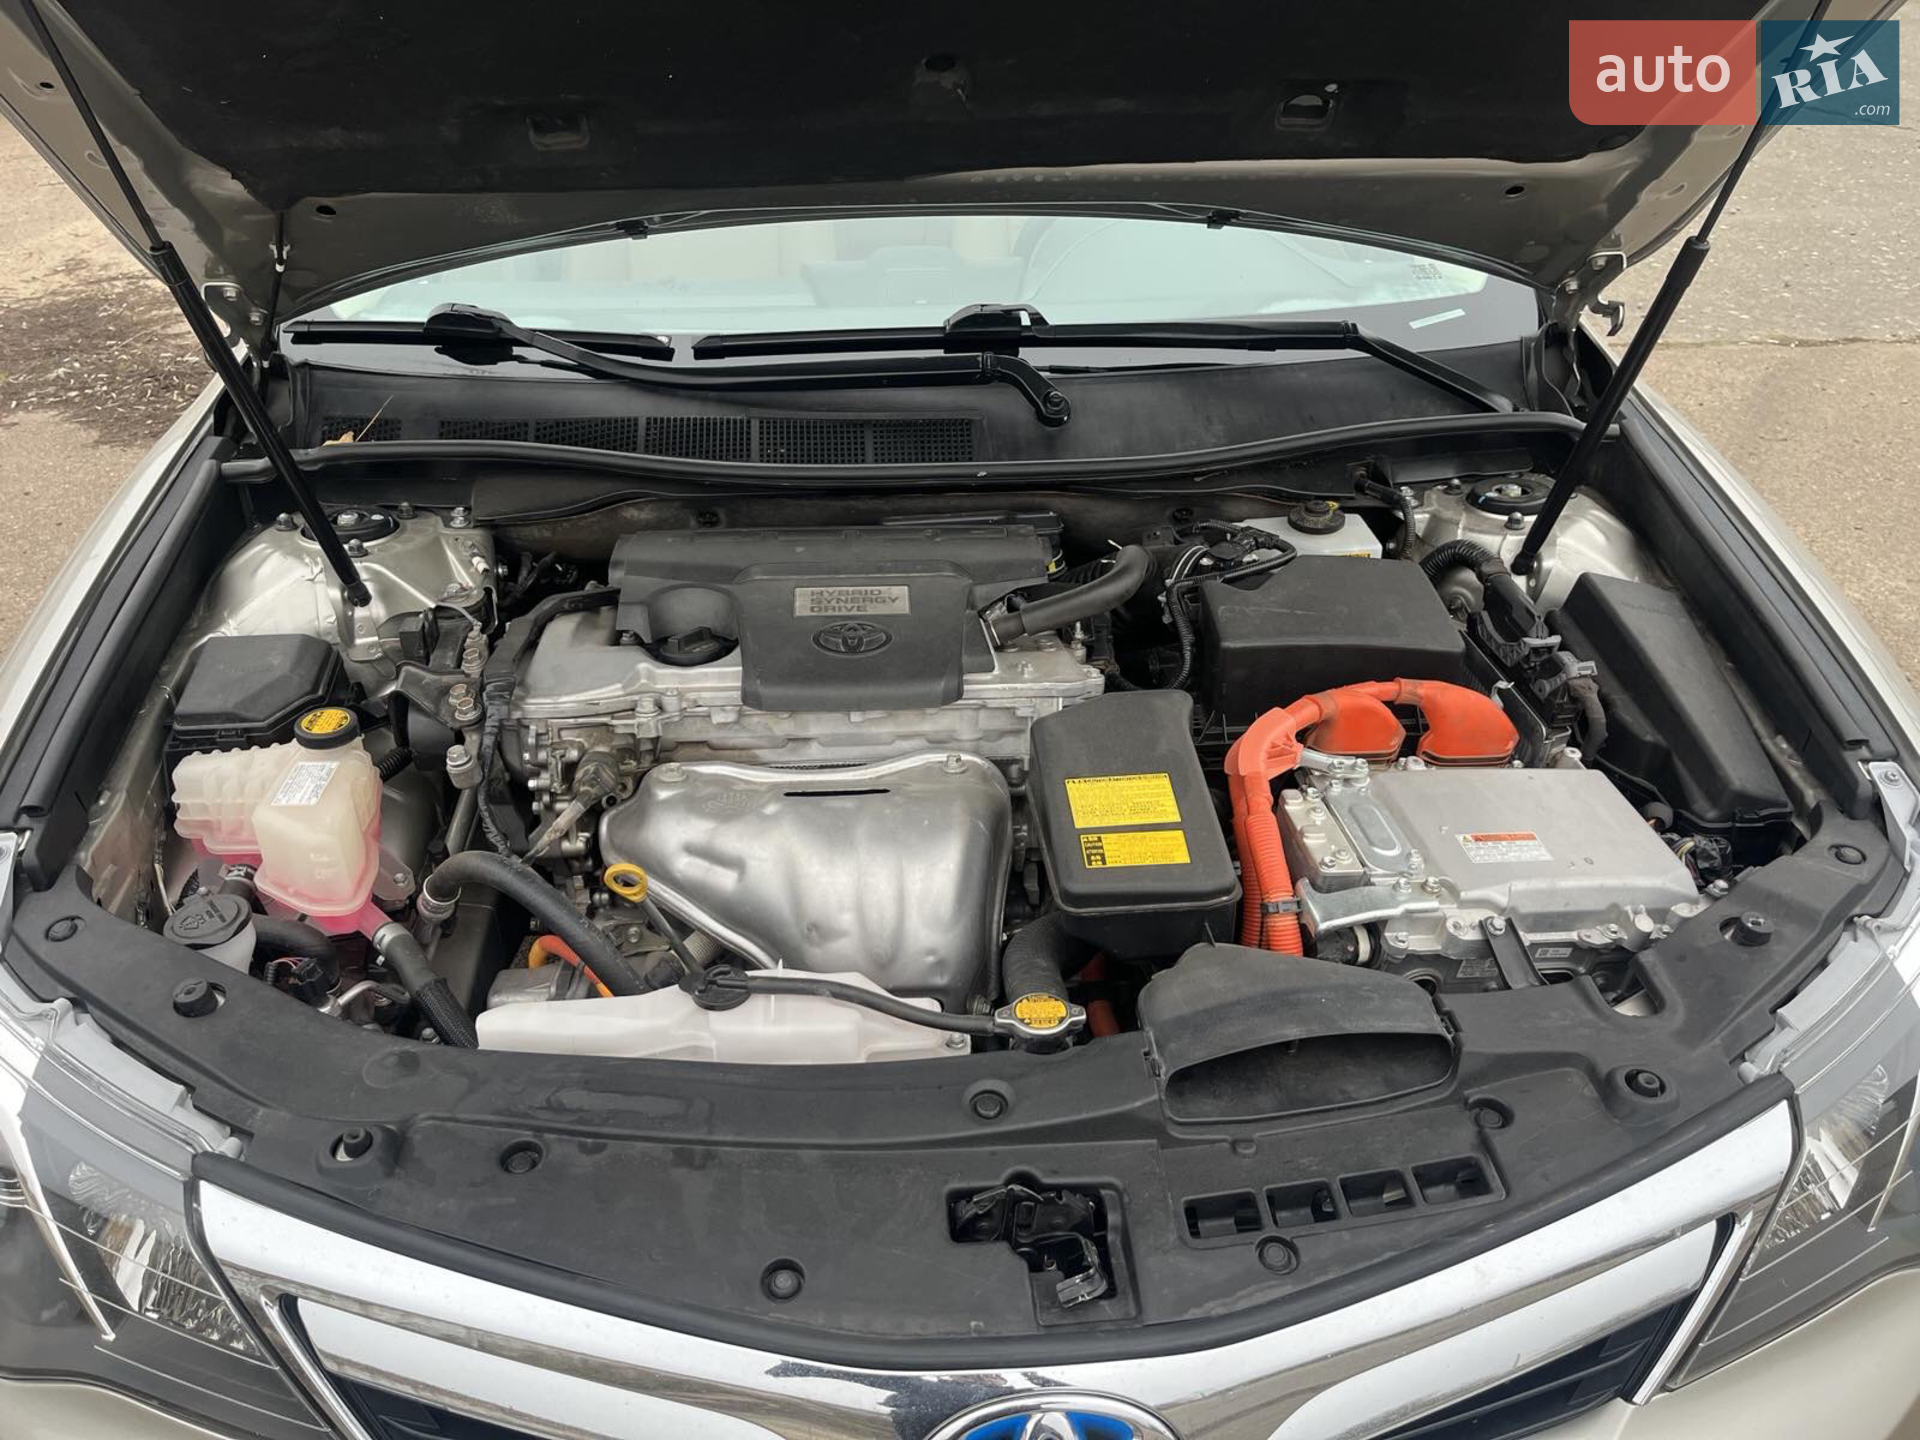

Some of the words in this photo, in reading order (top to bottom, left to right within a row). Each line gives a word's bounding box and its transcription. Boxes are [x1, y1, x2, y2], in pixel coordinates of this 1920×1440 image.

[810, 589, 882, 597] HYBRID
[810, 596, 899, 605] SYNERGY
[810, 604, 868, 613] DRIVE
